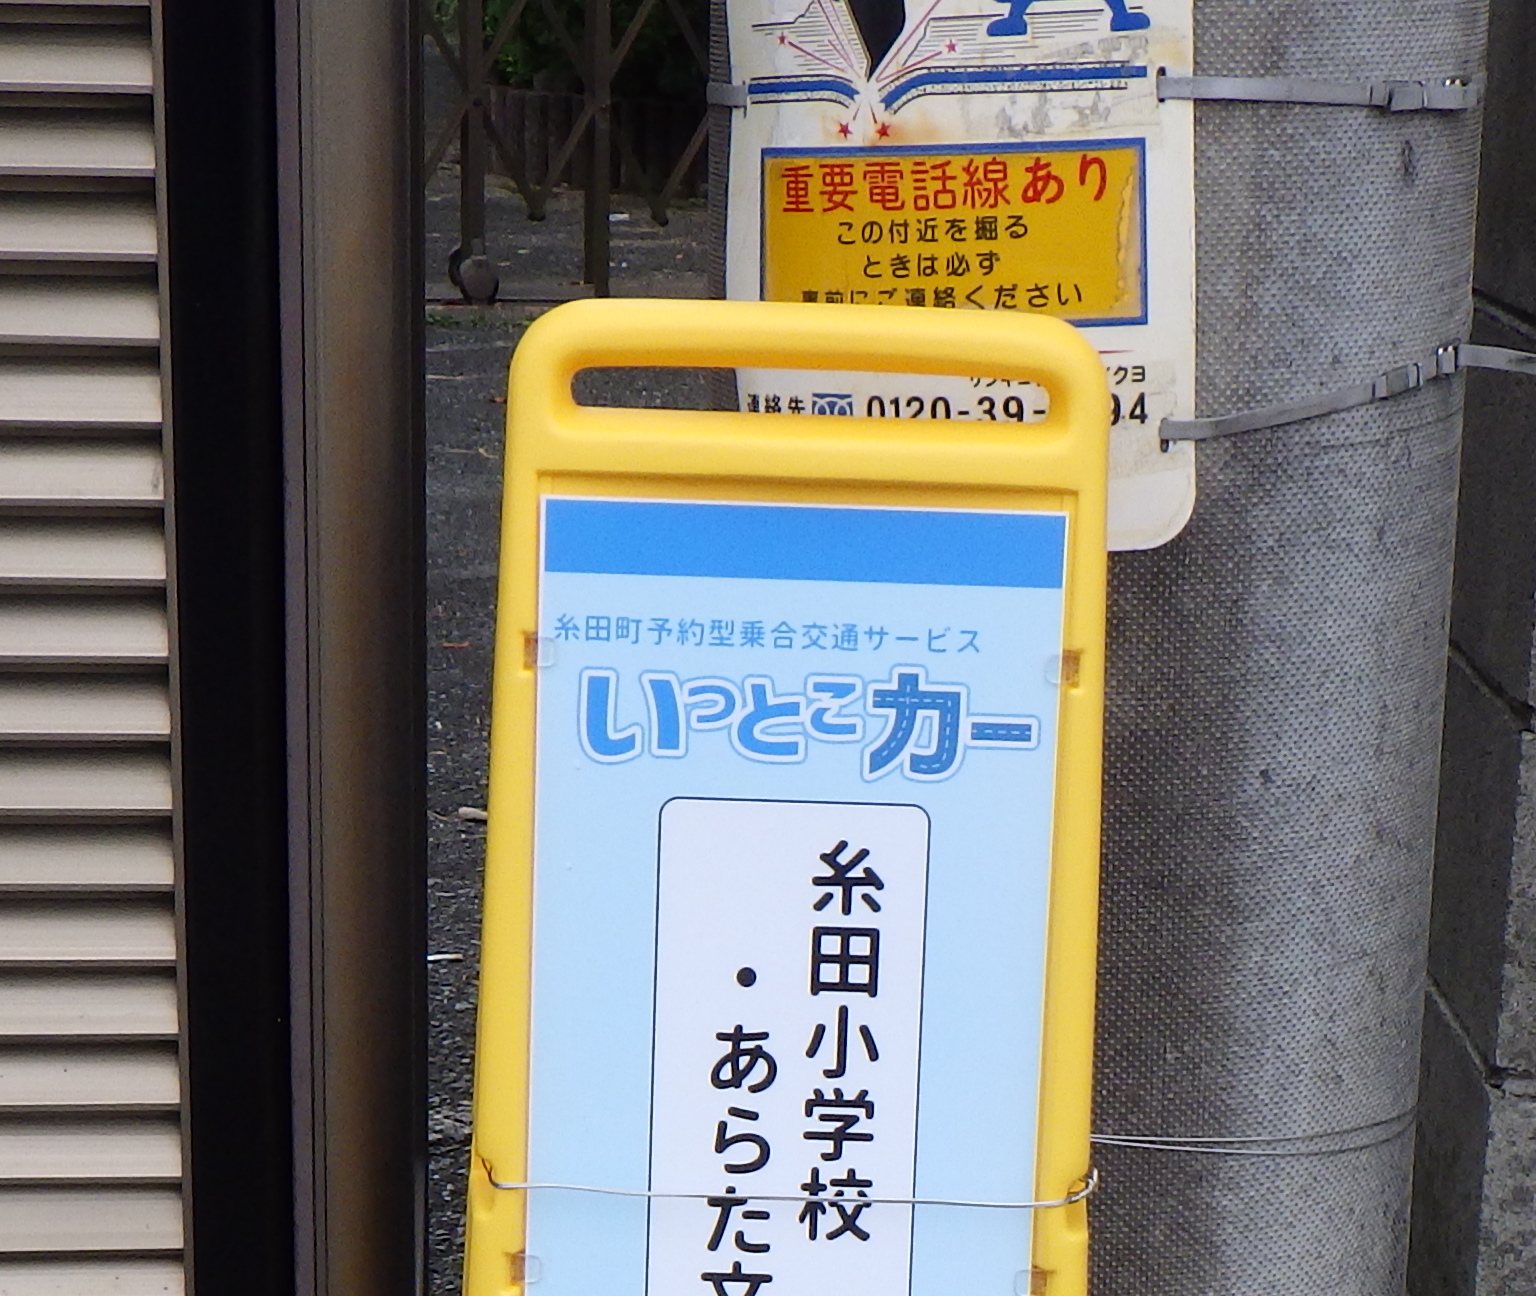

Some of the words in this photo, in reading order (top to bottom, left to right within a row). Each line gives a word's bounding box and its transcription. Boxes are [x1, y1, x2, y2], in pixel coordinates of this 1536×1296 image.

[780, 153, 1109, 214] 重要電話線あり
[836, 214, 1029, 246] この付近を掘る
[862, 249, 1001, 279] ときは必ず
[553, 612, 982, 654] 糸田町予約型乗合交通サービス
[582, 668, 1037, 779] いっとこカー
[797, 839, 885, 1242] 糸田小学校
